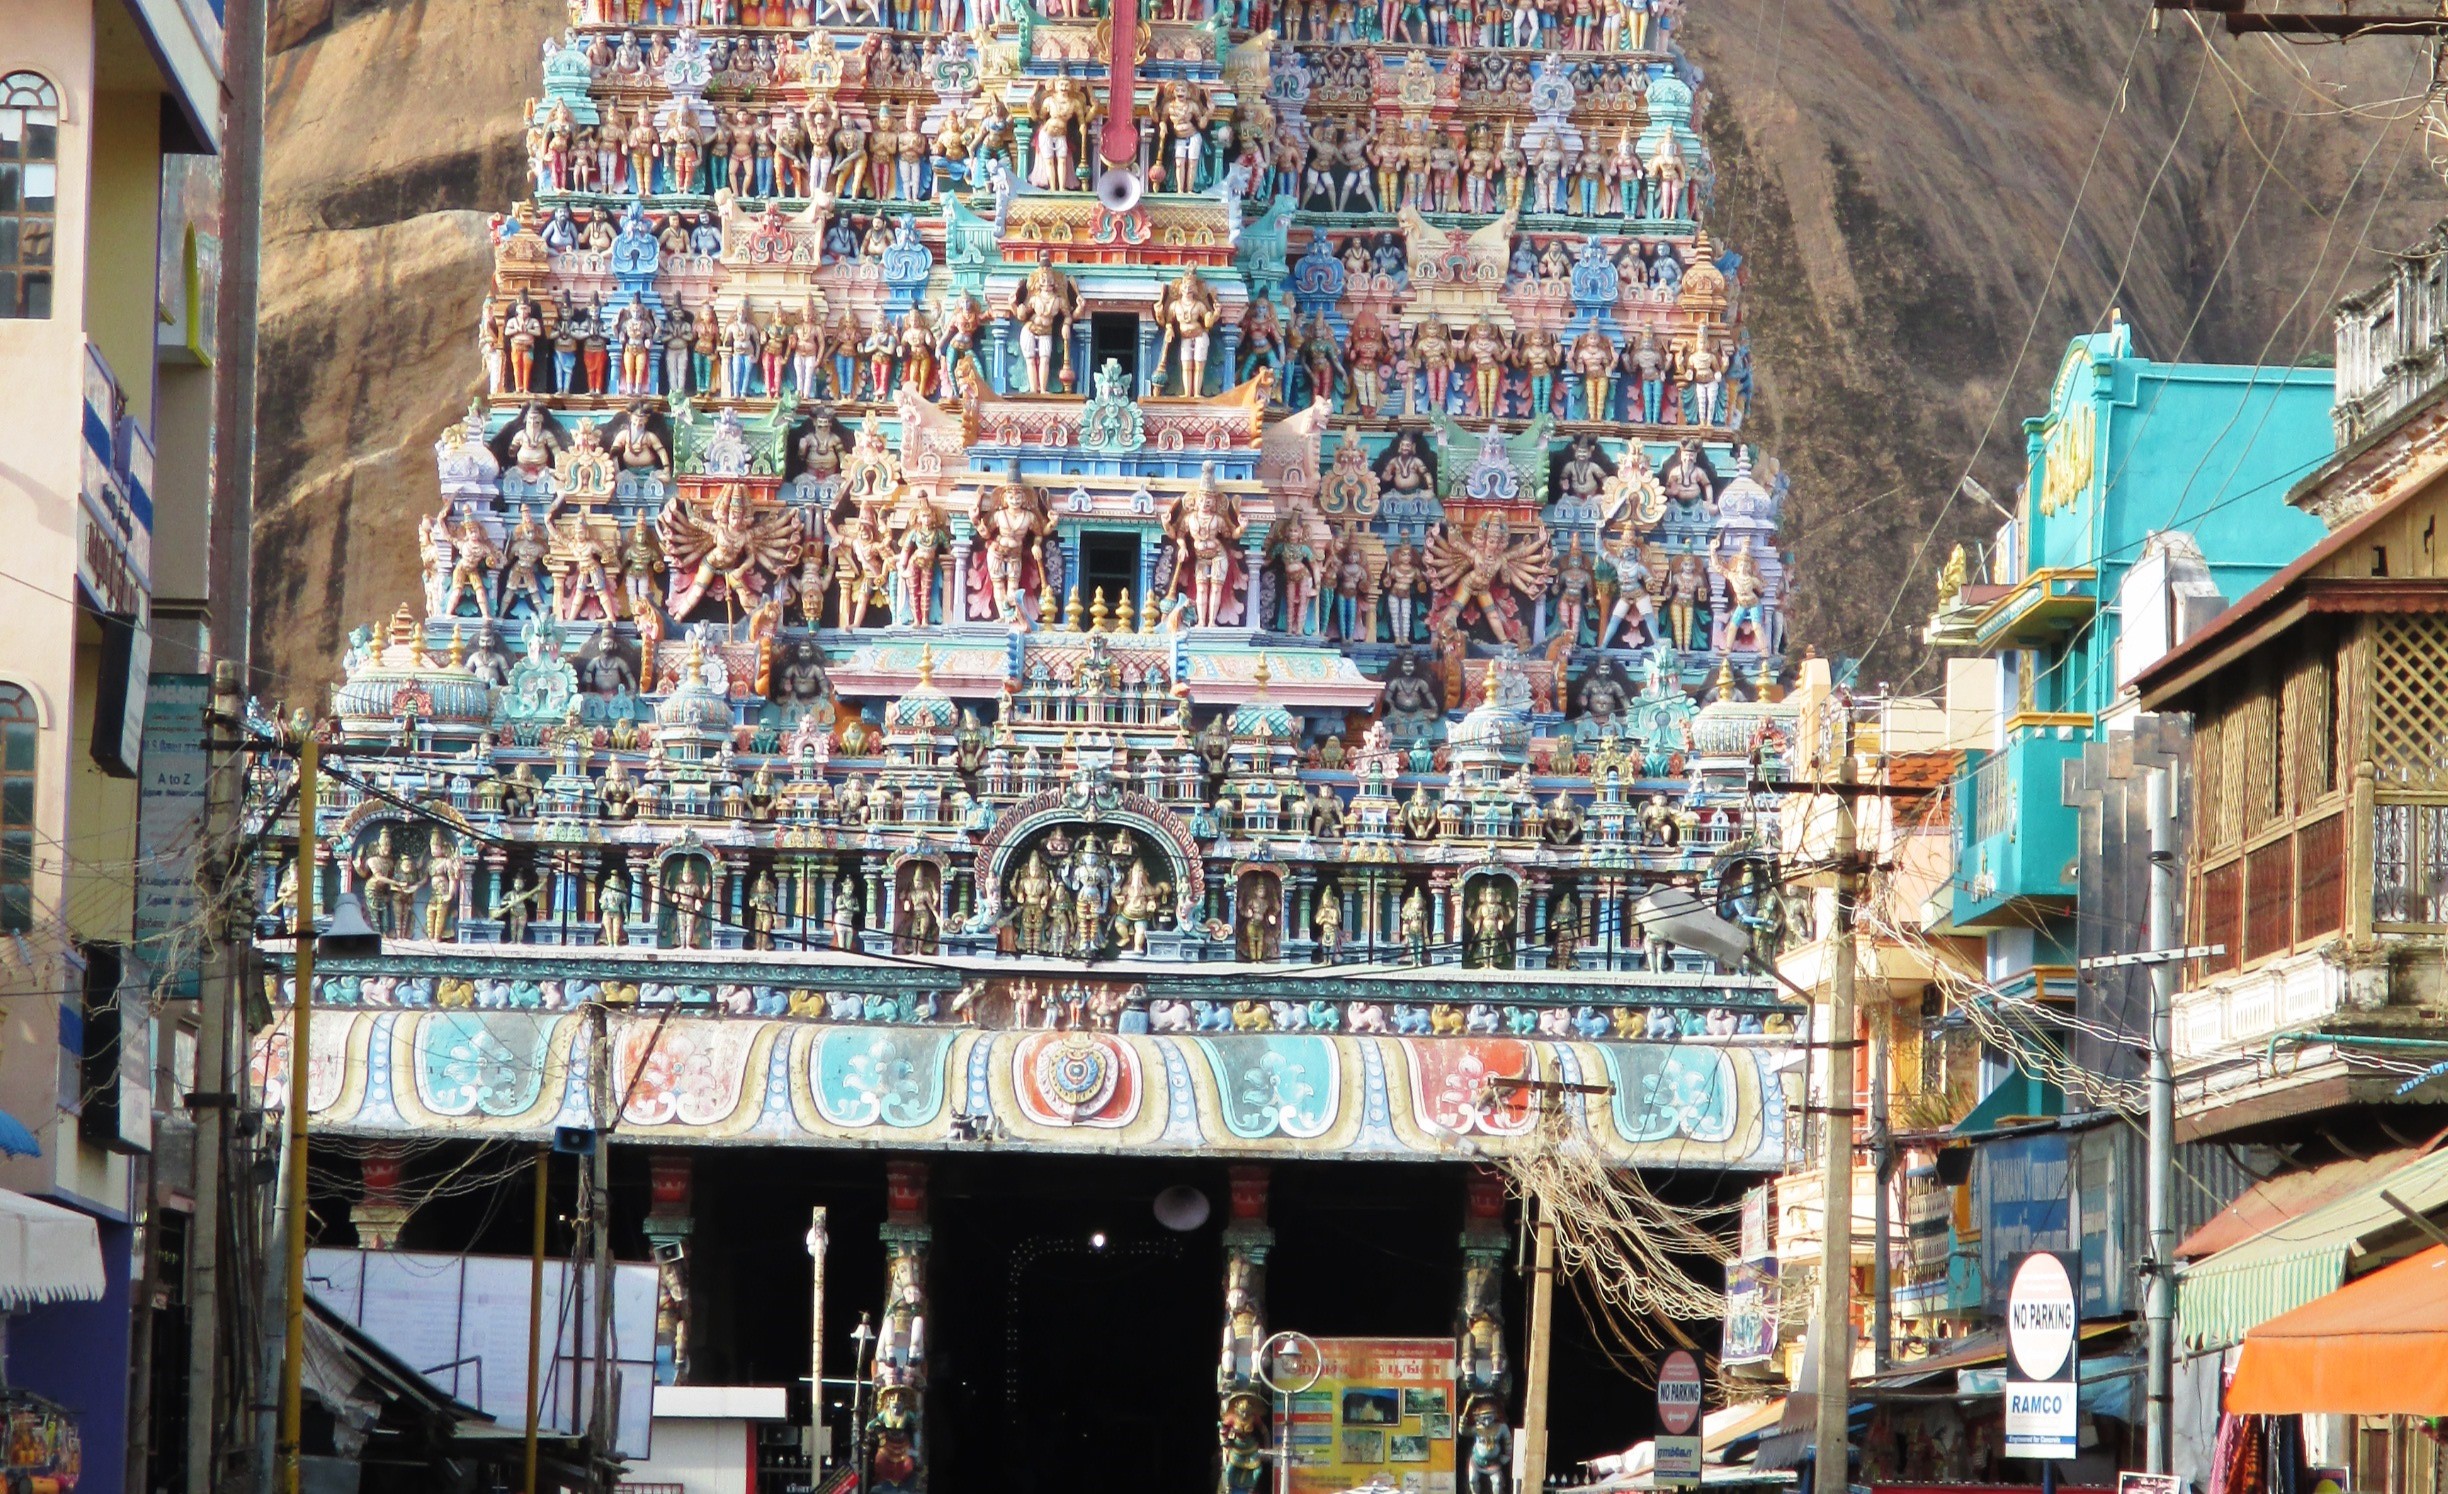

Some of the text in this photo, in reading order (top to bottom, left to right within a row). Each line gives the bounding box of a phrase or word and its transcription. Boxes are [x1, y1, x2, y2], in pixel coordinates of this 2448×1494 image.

[158, 772, 191, 785] A to Z
[2013, 1303, 2071, 1330] NO PARKING
[1660, 1382, 1699, 1402] NO PARKING
[2012, 1395, 2062, 1414] RAMCO
